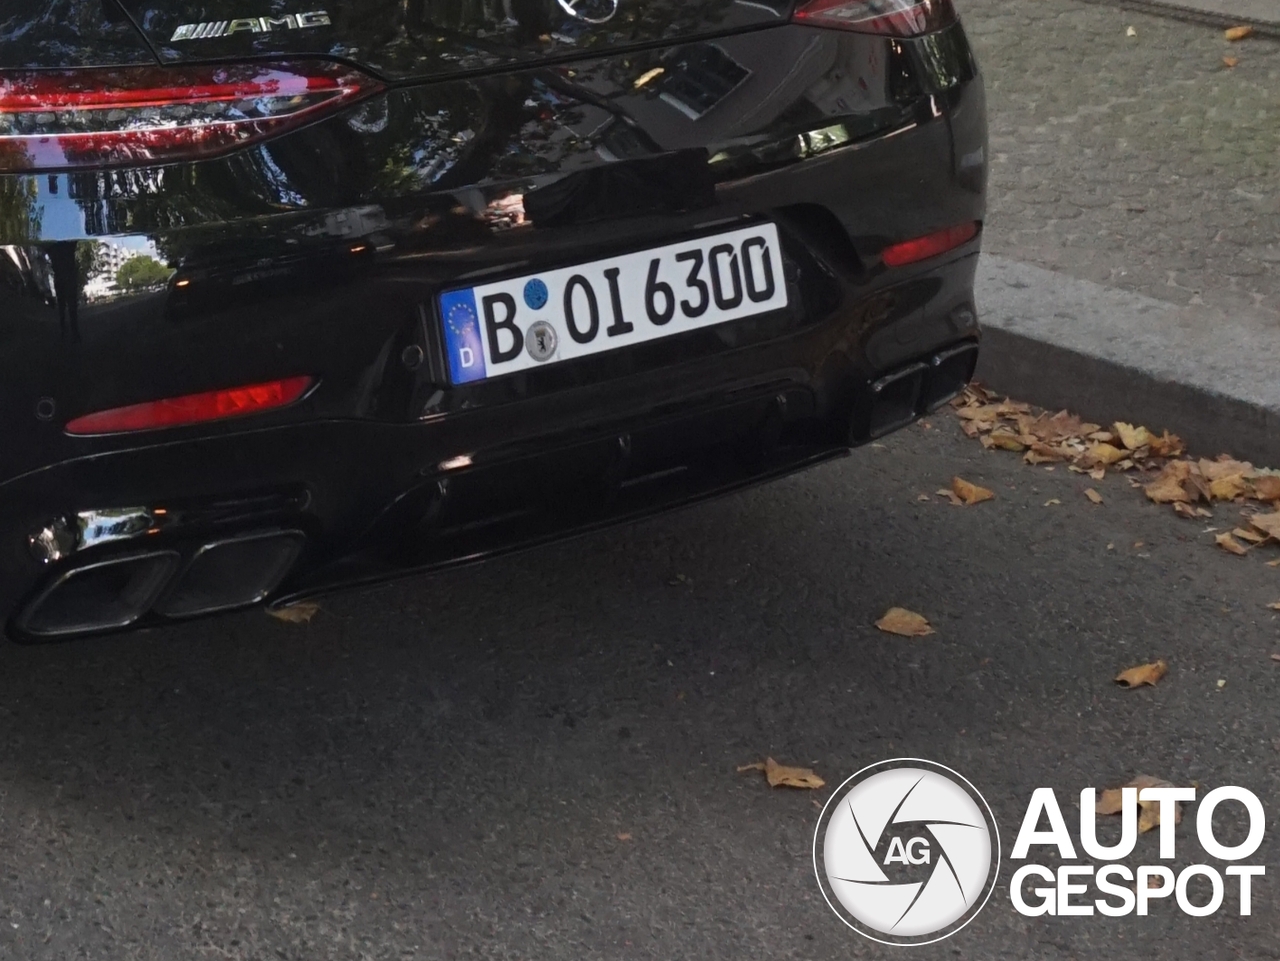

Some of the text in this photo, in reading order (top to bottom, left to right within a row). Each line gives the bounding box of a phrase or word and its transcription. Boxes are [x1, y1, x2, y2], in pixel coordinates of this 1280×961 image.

[223, 10, 332, 36] AMG
[482, 235, 776, 364] B OI 6300
[460, 347, 474, 368] D
